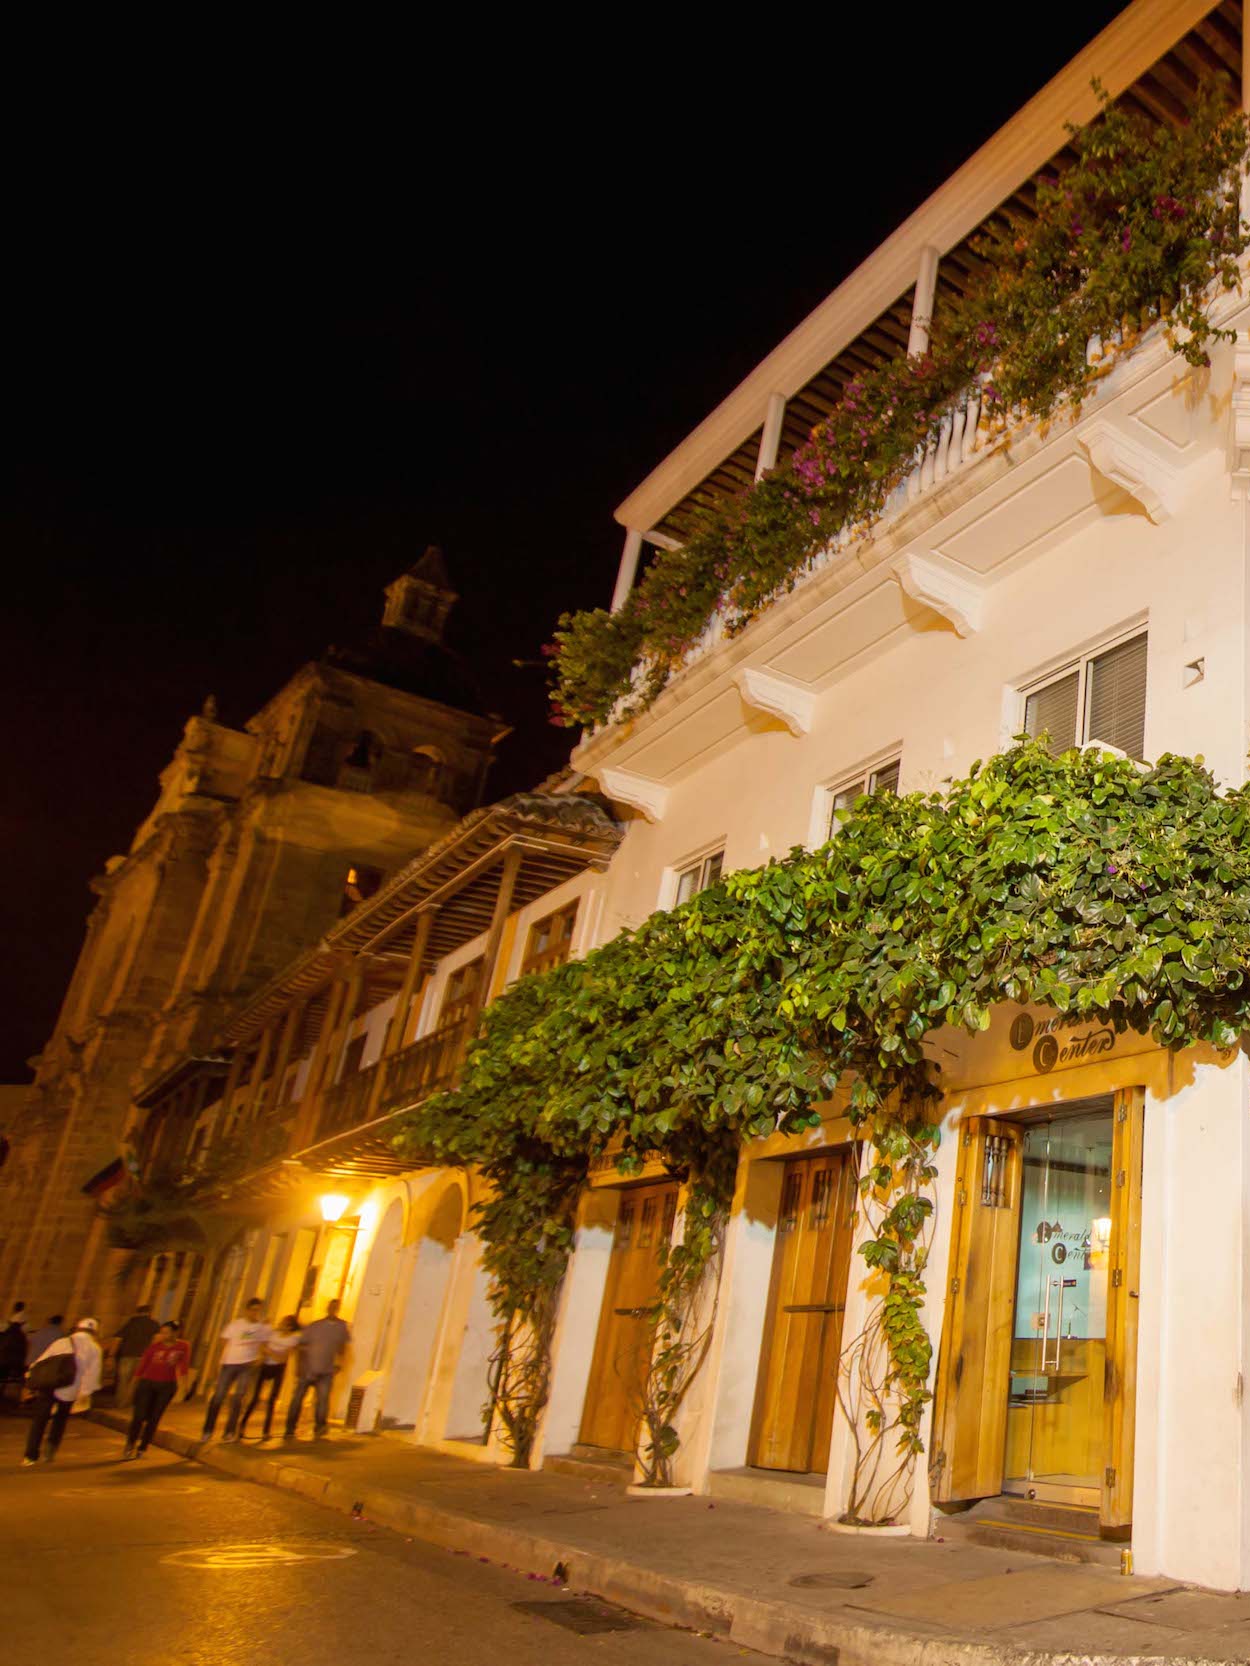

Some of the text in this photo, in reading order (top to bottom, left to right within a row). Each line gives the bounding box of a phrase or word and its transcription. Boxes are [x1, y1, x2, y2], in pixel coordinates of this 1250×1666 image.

[1009, 1012, 1098, 1051] Emer
[1033, 1028, 1115, 1074] Center
[1036, 1221, 1093, 1244] merald
[1052, 1242, 1091, 1265] Cent
